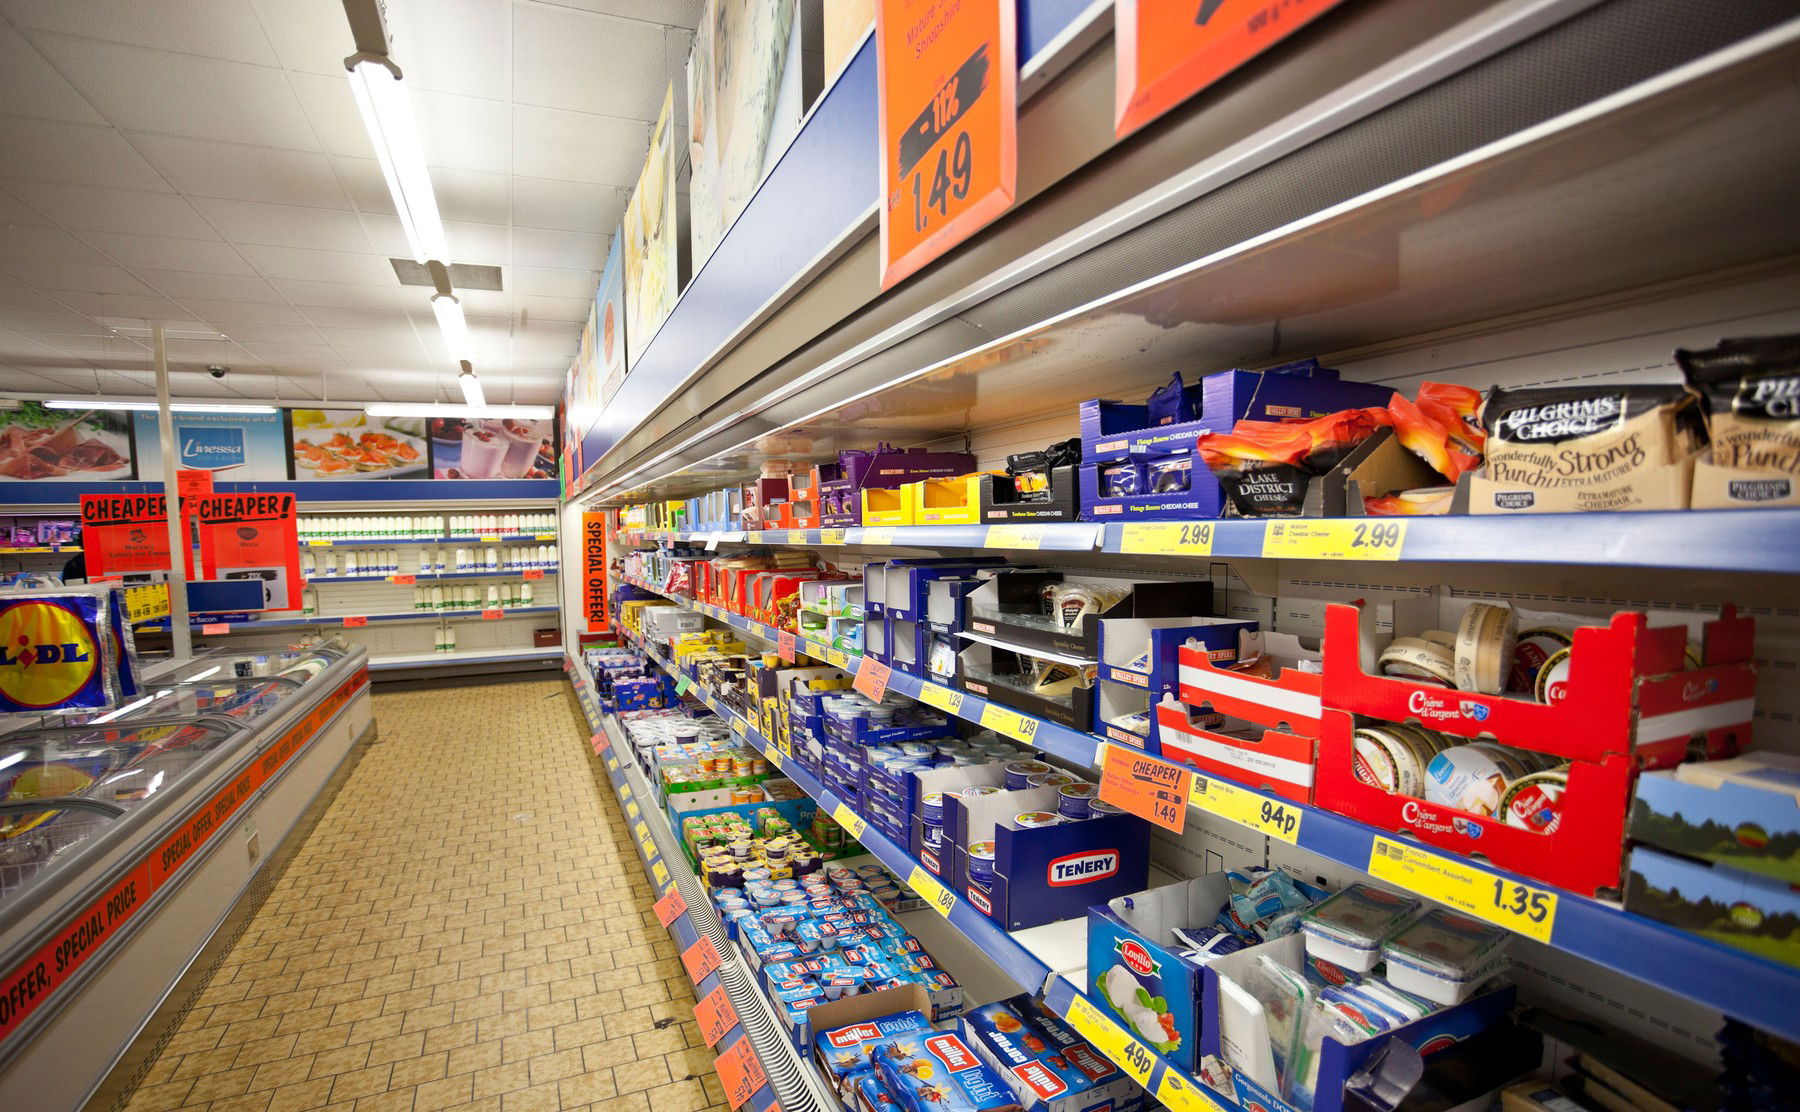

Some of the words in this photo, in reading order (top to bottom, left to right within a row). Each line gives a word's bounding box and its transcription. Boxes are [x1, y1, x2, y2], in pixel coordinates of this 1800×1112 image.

[907, 4, 936, 45] Mature
[912, 130, 972, 233] 1.49
[1508, 396, 1615, 428] PILGRIMS
[1516, 416, 1597, 440] CHOICE
[183, 439, 241, 457] Linessa
[1490, 450, 1556, 473] wonderfully
[1557, 432, 1645, 476] Strong
[1238, 483, 1294, 496] DISTRICT
[1248, 473, 1279, 484] LAKE
[1253, 494, 1282, 502] CHEESE
[1496, 493, 1533, 501] PILGRIMS
[1500, 500, 1529, 508] CHOICE
[1577, 491, 1601, 500] EXTRA
[1602, 486, 1632, 499] MATURE
[1583, 498, 1631, 509] CHEDDAR
[200, 496, 292, 519] CHEAPER!
[1179, 524, 1210, 545] 2.99
[1352, 523, 1400, 548] 2.99
[587, 521, 603, 574] SPECIAL
[589, 578, 605, 623] OFFER!
[1408, 690, 1445, 714] Chêne
[1421, 707, 1460, 721] d'argent
[1019, 718, 1036, 736] 1.29
[1133, 760, 1182, 790] CHEAPER!
[162, 836, 192, 872] SPECIAL
[192, 810, 215, 844] OFFER,
[215, 790, 236, 822] SPECIAL
[236, 776, 251, 802] PRICE
[1154, 801, 1177, 824] 1.49
[1260, 800, 1296, 834] 94p
[1402, 801, 1437, 824] Chêne
[1414, 817, 1454, 834] d'argent
[922, 854, 939, 872] TENERY
[1405, 846, 1428, 860] French
[1056, 856, 1114, 880] TENERY
[1403, 854, 1441, 874] Camembert
[1442, 868, 1473, 885] Assorted
[937, 888, 954, 910] 1.89
[969, 889, 991, 912] TENERY
[1492, 878, 1550, 923] 1.35
[0, 963, 51, 1025] OFFER,
[55, 912, 105, 973] SPECIAL
[107, 881, 137, 925] PRICE
[1124, 944, 1152, 969] Lovilio
[835, 1027, 875, 1044] müller
[879, 1015, 917, 1035] light
[1036, 1015, 1076, 1044] corner
[989, 1030, 1028, 1064] corner
[1123, 1041, 1152, 1075] 49p
[935, 1038, 968, 1068] müller
[961, 1068, 1000, 1102] light
[1073, 1049, 1108, 1074] müller
[1024, 1065, 1060, 1093] müller
[1235, 1072, 1271, 1106] Gorgonzola
